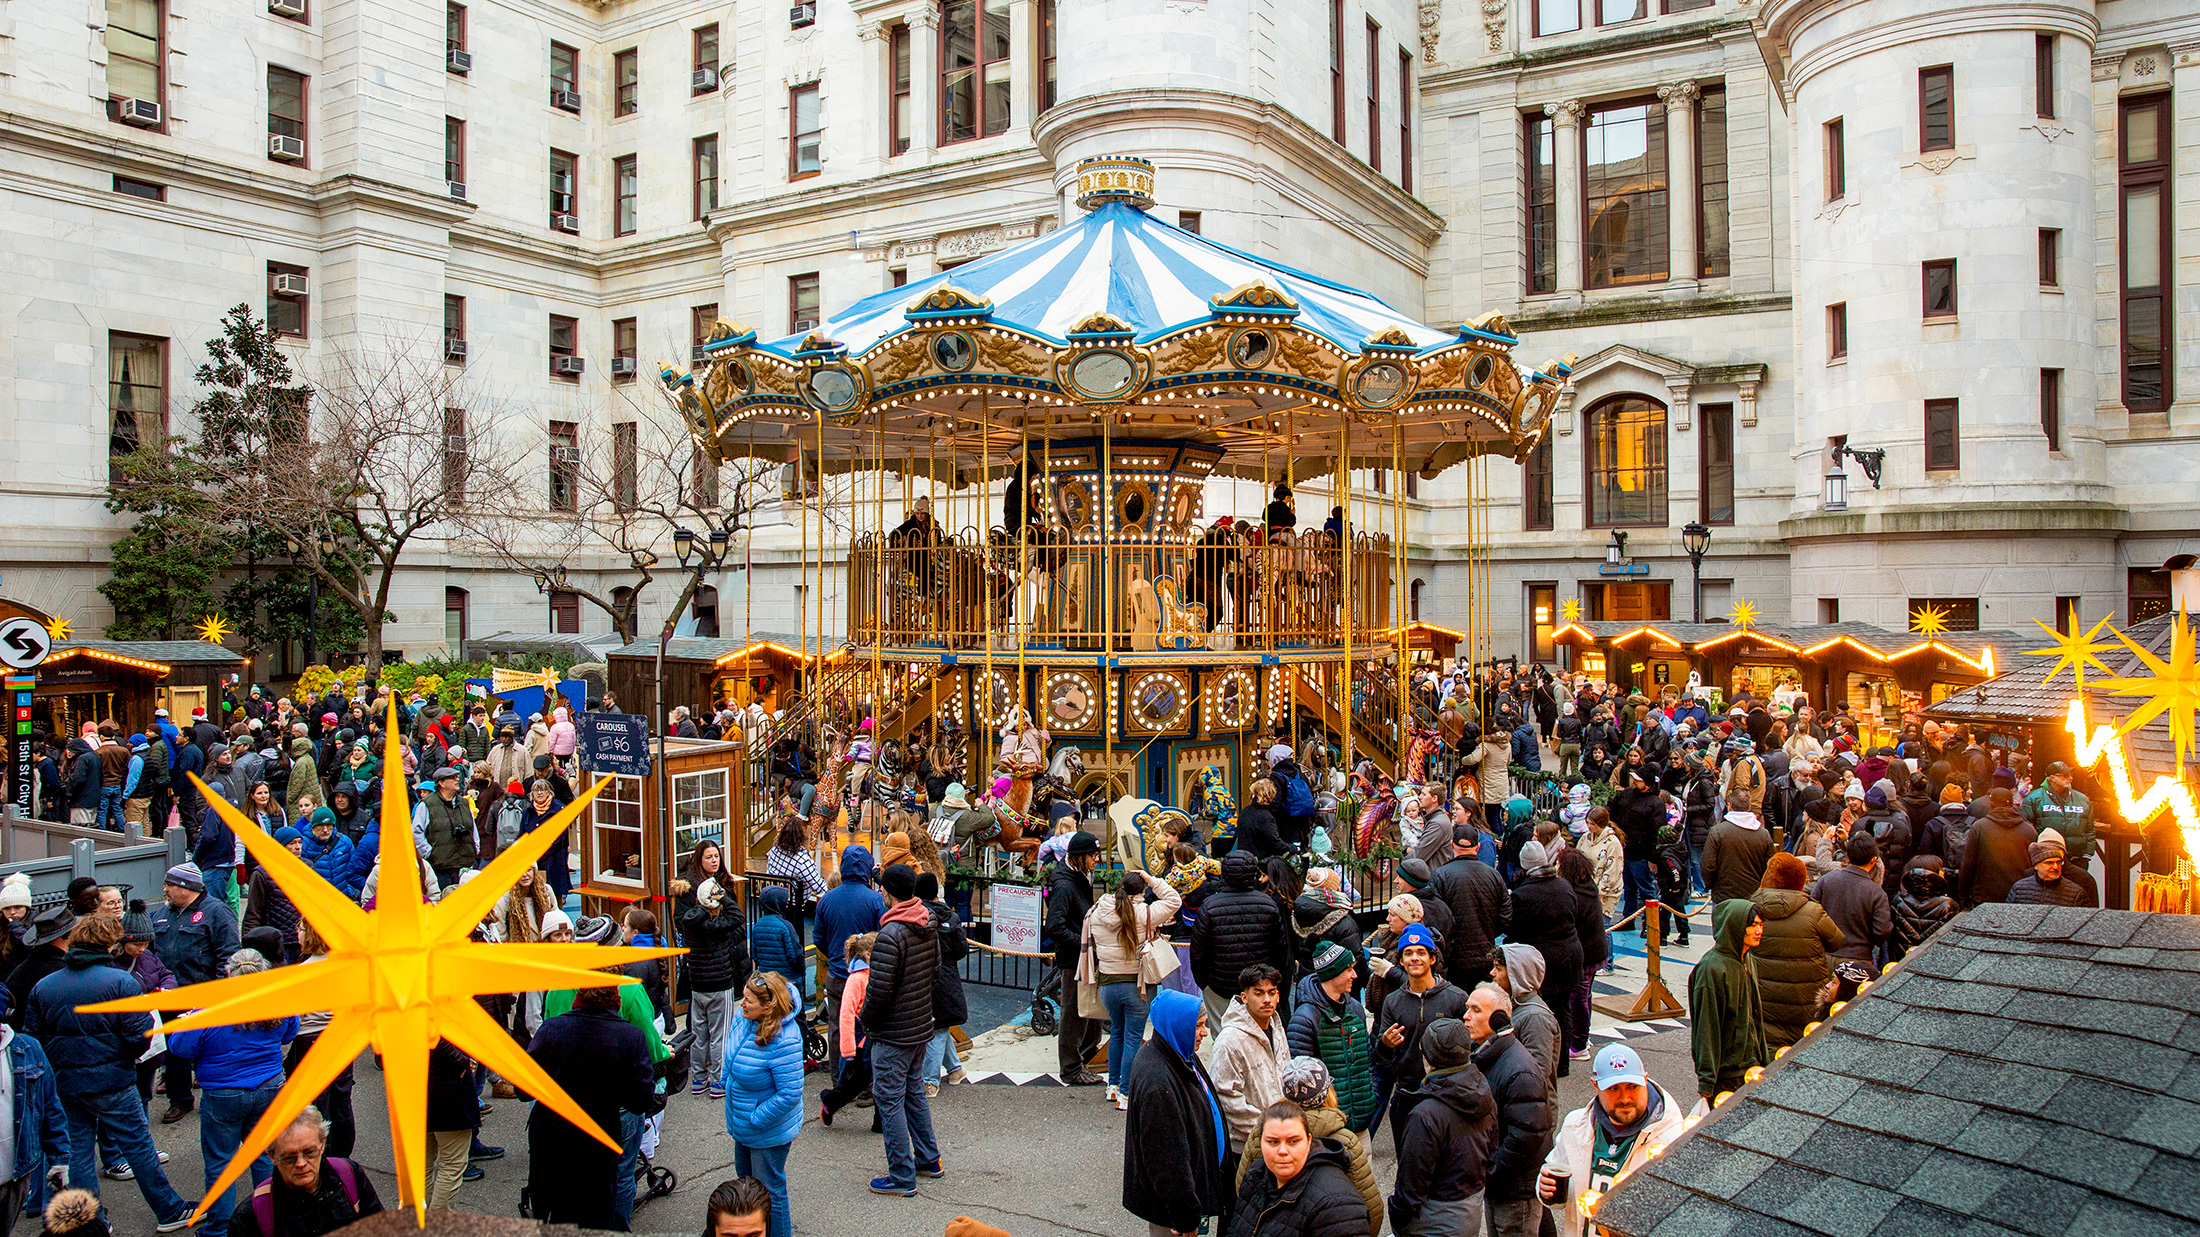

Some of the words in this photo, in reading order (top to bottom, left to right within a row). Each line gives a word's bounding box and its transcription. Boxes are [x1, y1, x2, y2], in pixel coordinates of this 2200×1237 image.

[596, 722, 628, 732] CAROUSEL
[613, 736, 630, 752] $6
[1989, 733, 2006, 746] Pick
[2007, 735, 2020, 751] Up
[18, 740, 31, 762] 15th
[595, 753, 609, 761] CASH
[609, 754, 633, 762] PAYMENT
[18, 764, 30, 776] St
[17, 784, 31, 805] City
